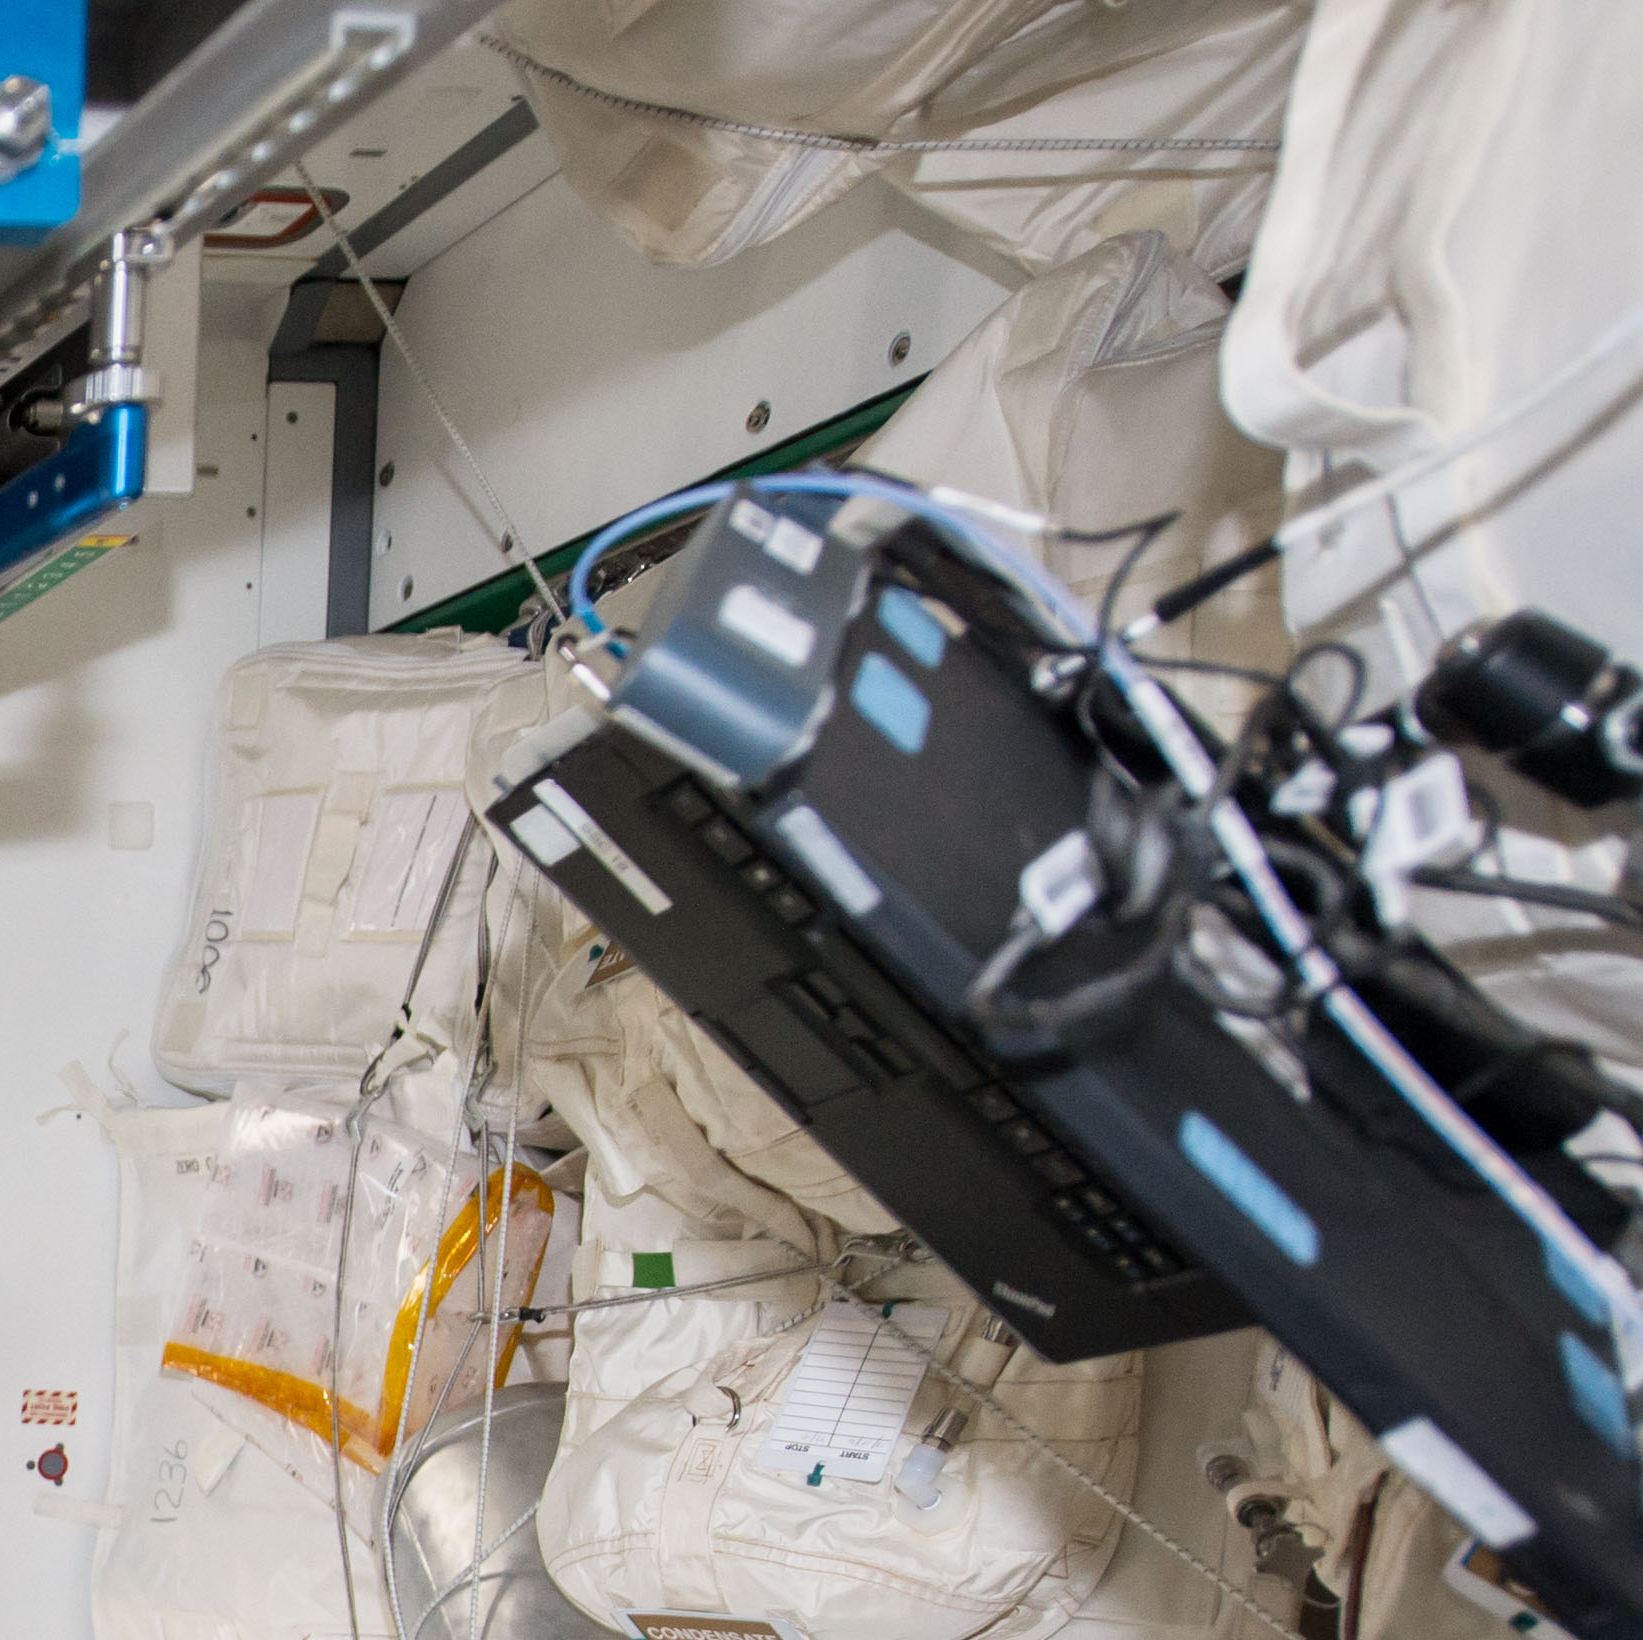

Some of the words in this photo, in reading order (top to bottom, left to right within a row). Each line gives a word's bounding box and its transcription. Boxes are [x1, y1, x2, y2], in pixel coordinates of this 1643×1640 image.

[785, 1443, 811, 1453] STOP
[839, 1450, 870, 1460] START
[152, 1438, 190, 1525] 1236
